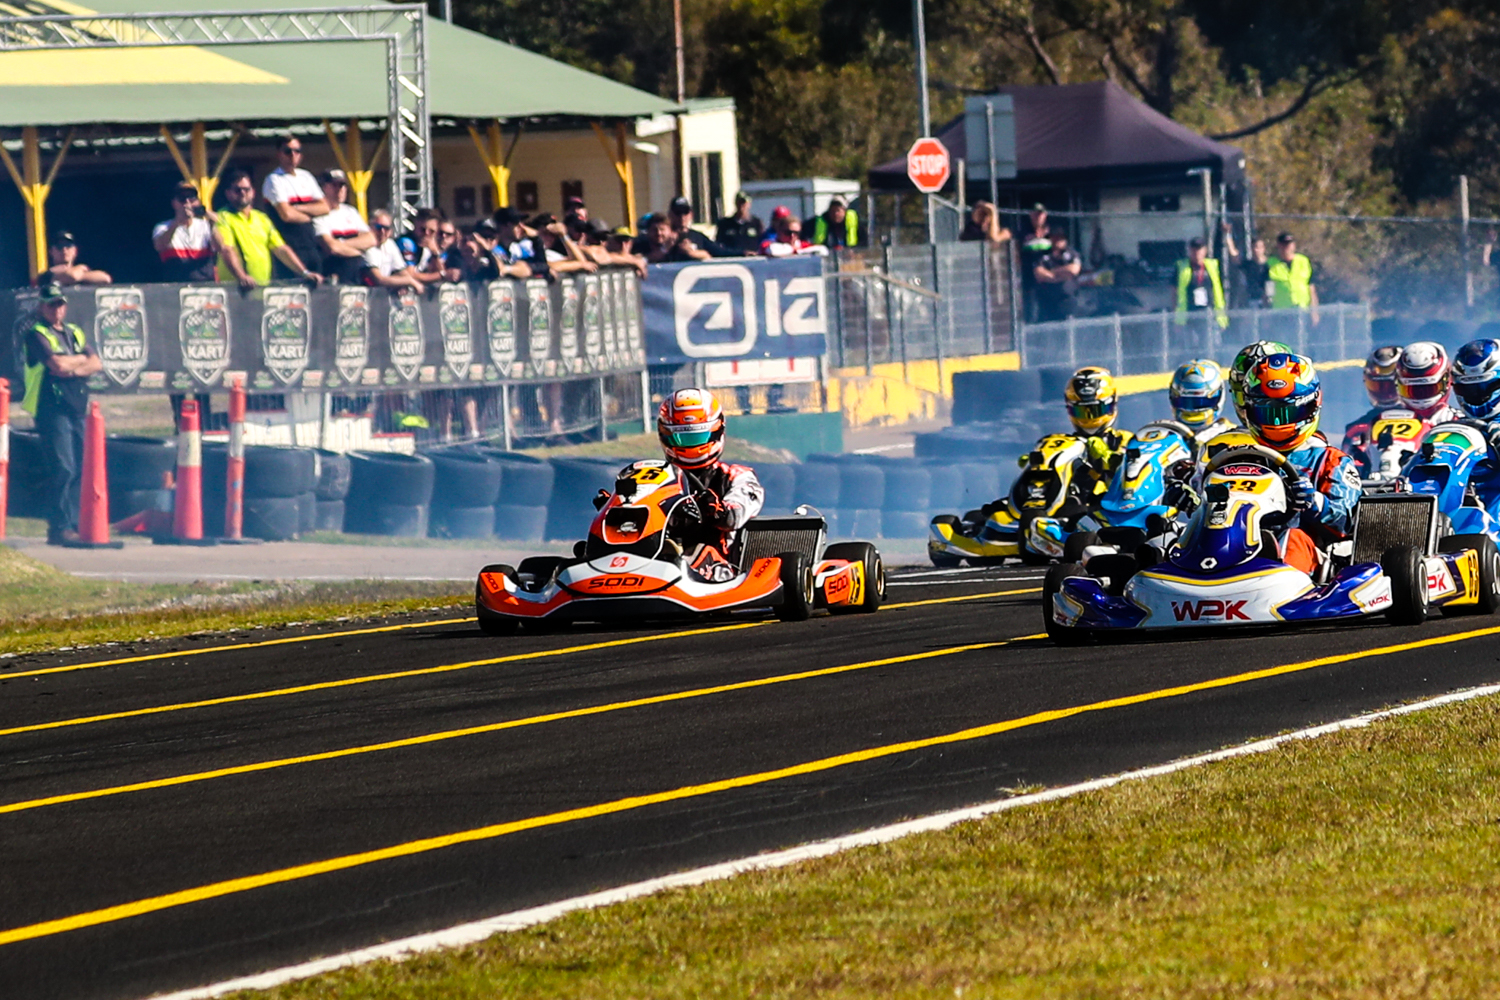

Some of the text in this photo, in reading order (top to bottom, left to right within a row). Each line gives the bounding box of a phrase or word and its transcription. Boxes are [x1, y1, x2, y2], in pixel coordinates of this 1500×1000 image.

[911, 155, 946, 175] STOP
[103, 345, 142, 360] KART
[187, 345, 224, 359] KART
[269, 345, 304, 358] KART
[1379, 423, 1412, 437] 42
[588, 577, 645, 589] SODI
[1368, 593, 1390, 608] WPK
[1170, 600, 1252, 621] WPK
